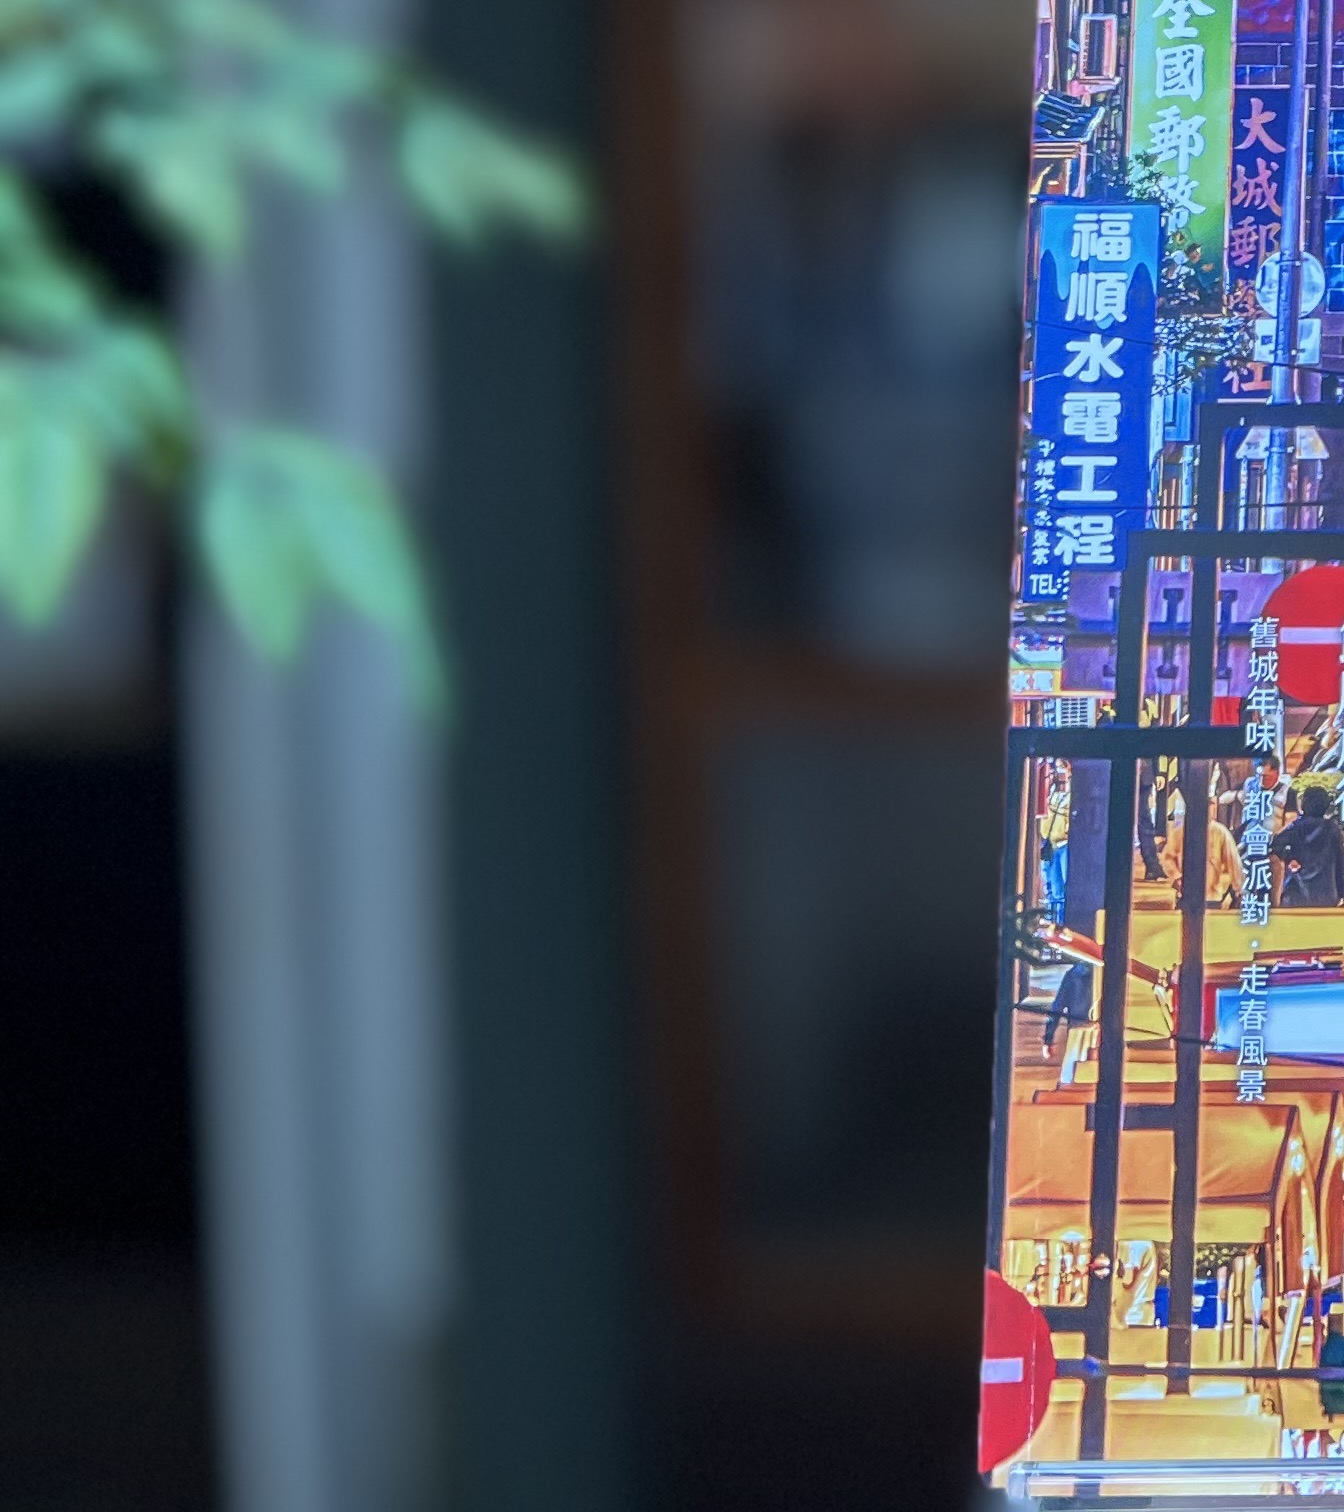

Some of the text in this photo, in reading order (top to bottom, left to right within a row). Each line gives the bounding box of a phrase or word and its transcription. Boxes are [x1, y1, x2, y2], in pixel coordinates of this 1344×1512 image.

[1054, 212, 1133, 567] 福順水電工程
